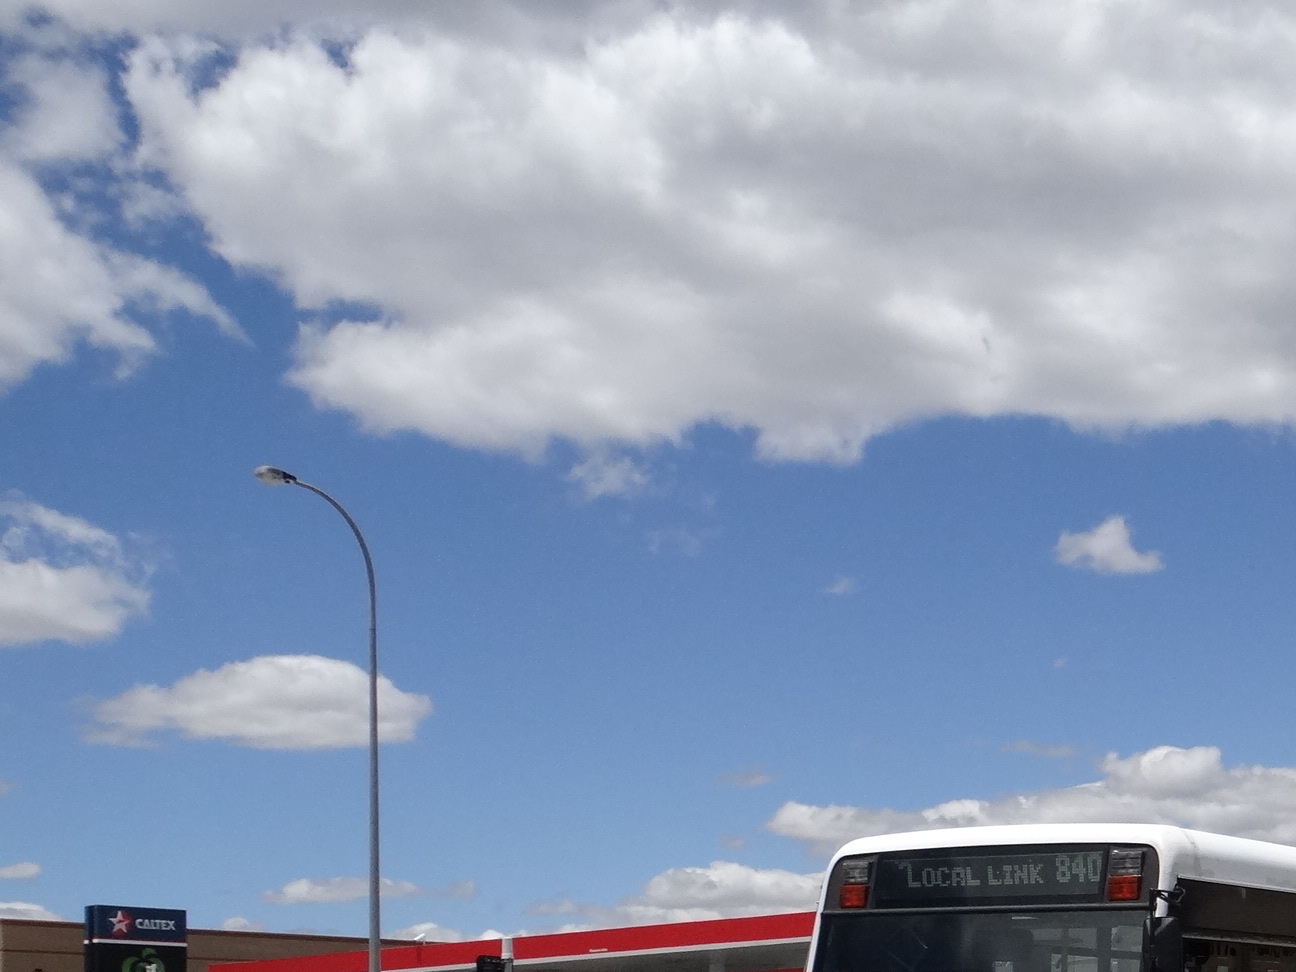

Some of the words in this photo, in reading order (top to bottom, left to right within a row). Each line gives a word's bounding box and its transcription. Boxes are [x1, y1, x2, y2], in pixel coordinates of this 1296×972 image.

[988, 863, 1044, 886] LINK
[1056, 854, 1102, 883] 840
[135, 918, 176, 931] CALTEX
